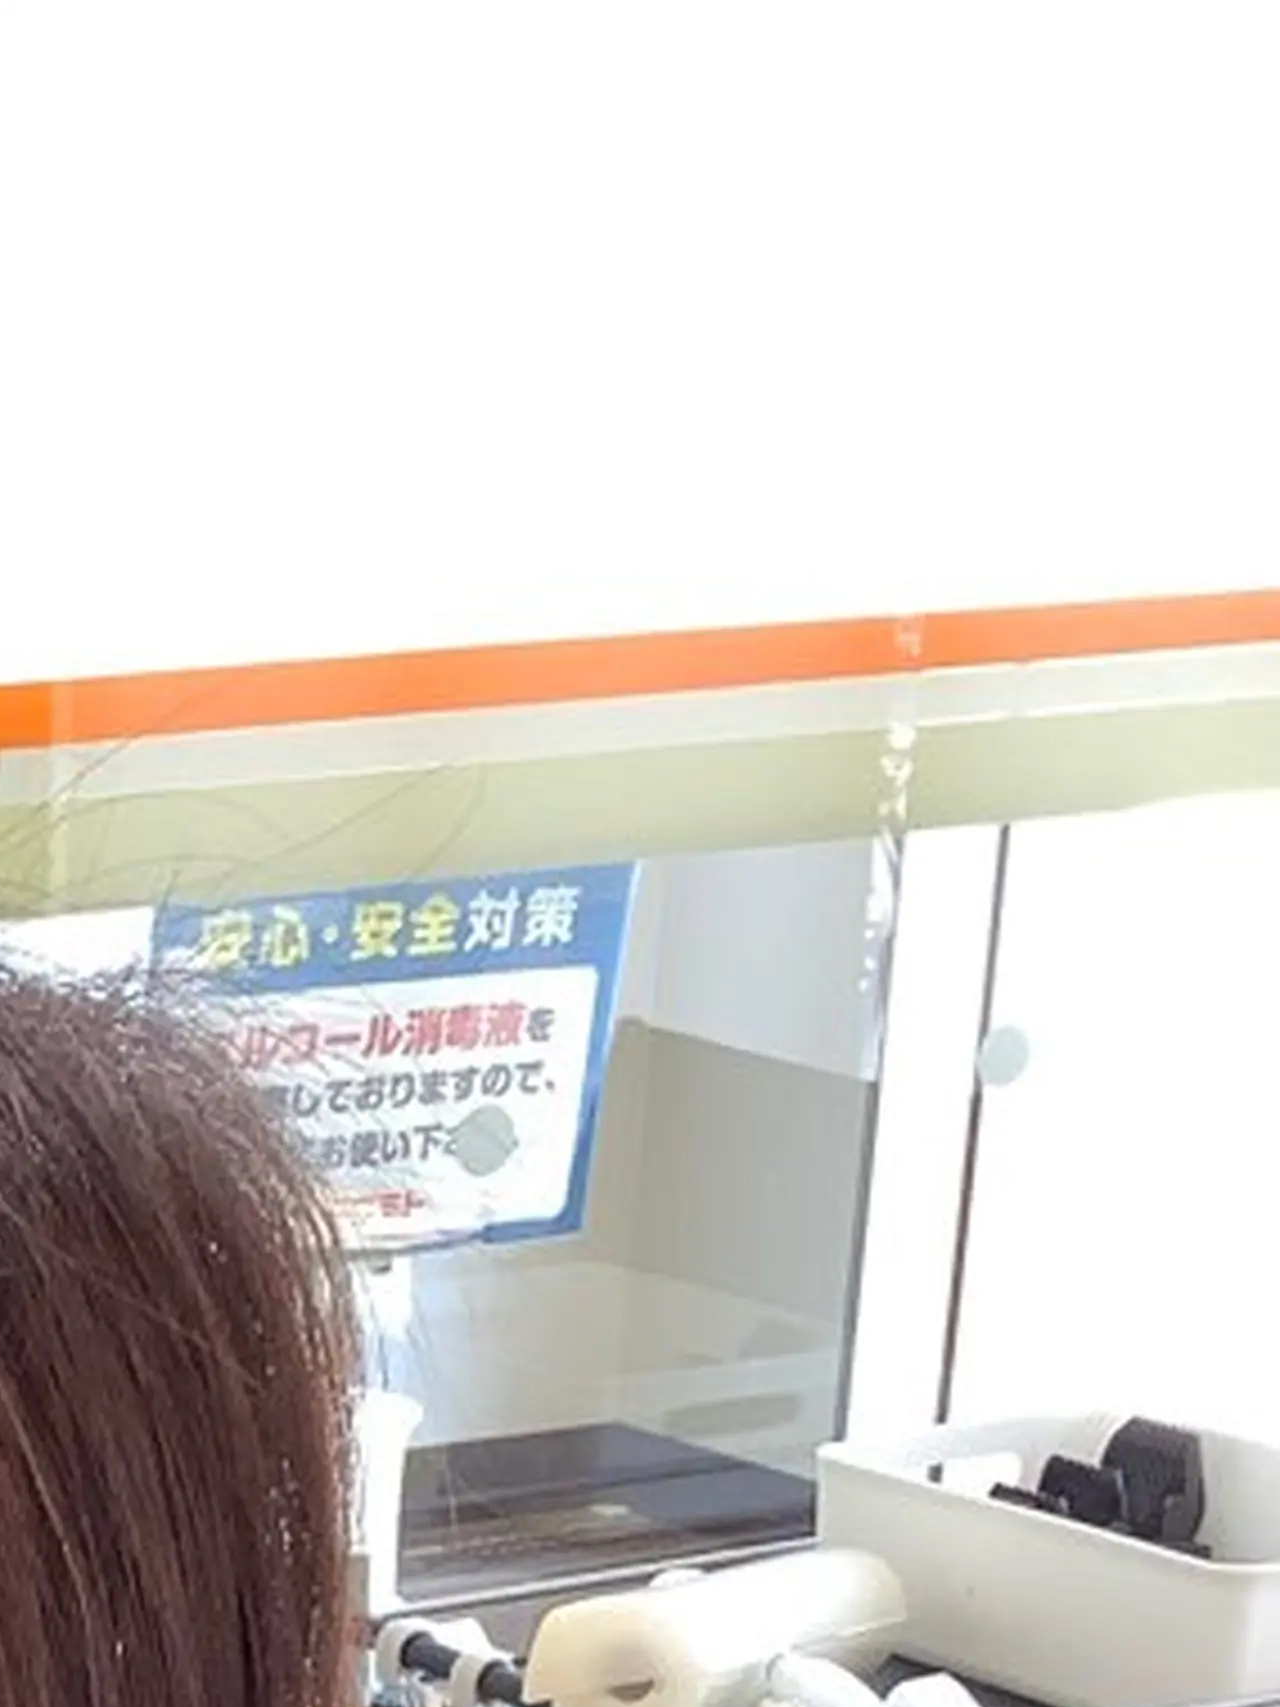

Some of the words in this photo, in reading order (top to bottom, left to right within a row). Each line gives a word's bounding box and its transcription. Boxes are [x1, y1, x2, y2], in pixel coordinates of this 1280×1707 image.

[238, 1000, 556, 1070] ルコール消毒液を
